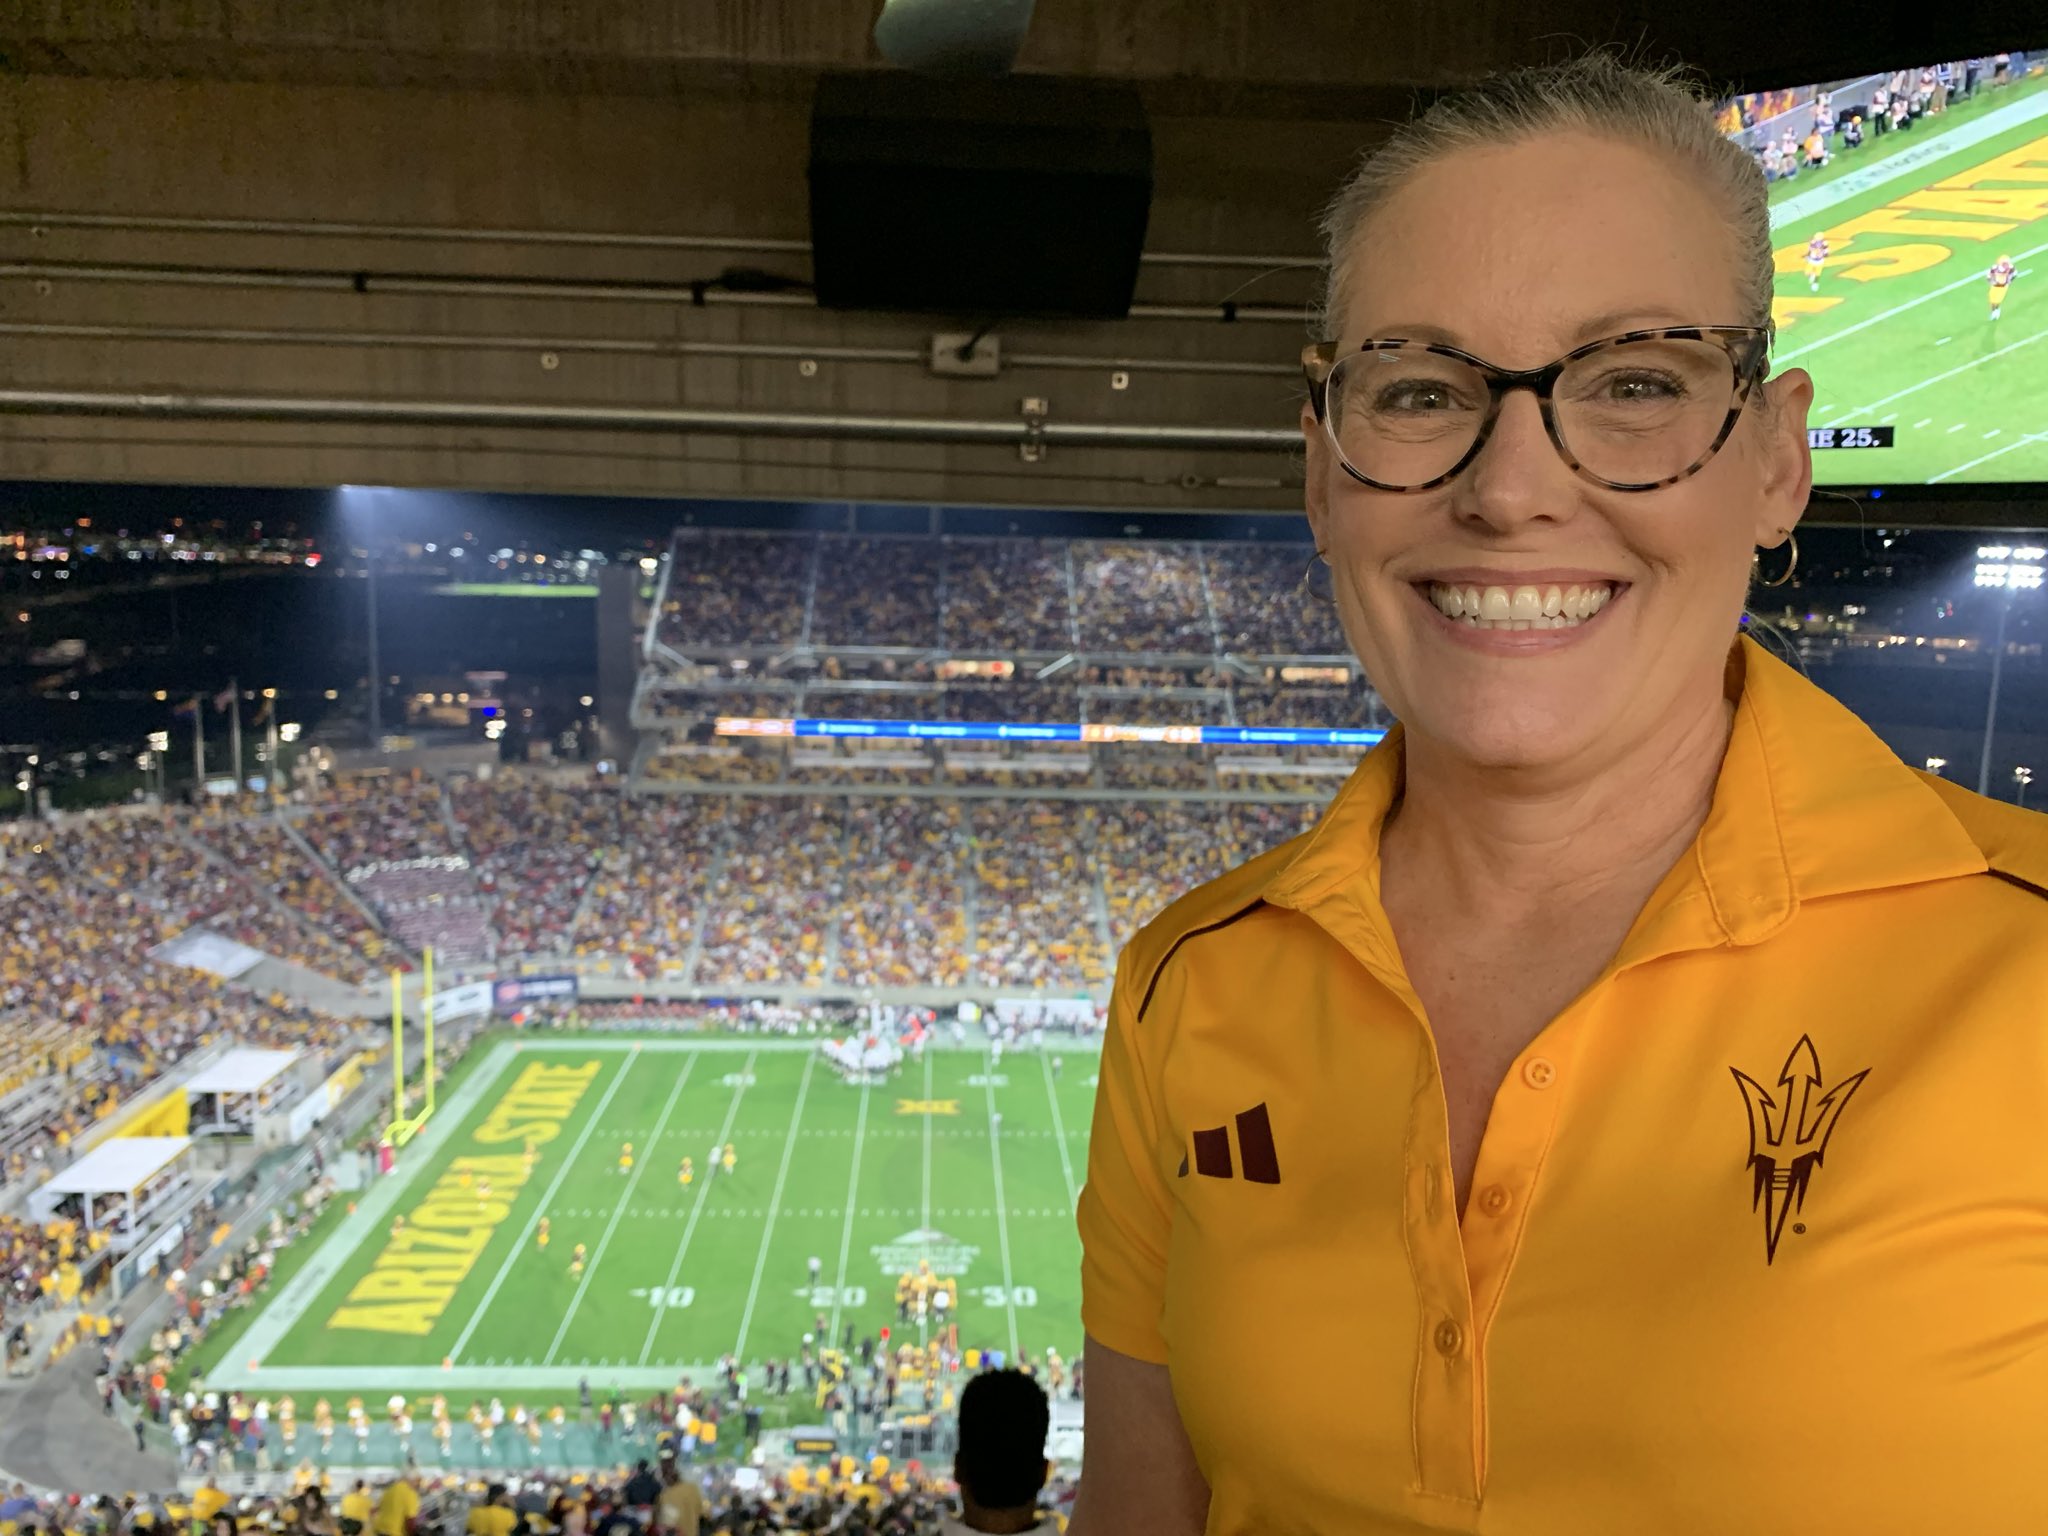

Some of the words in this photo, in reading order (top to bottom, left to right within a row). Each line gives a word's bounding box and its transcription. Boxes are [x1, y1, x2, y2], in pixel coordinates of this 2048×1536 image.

[1840, 428, 1880, 447] 25.
[473, 1059, 602, 1144] STATE
[648, 1286, 696, 1308] 10
[981, 1285, 1038, 1307] 30
